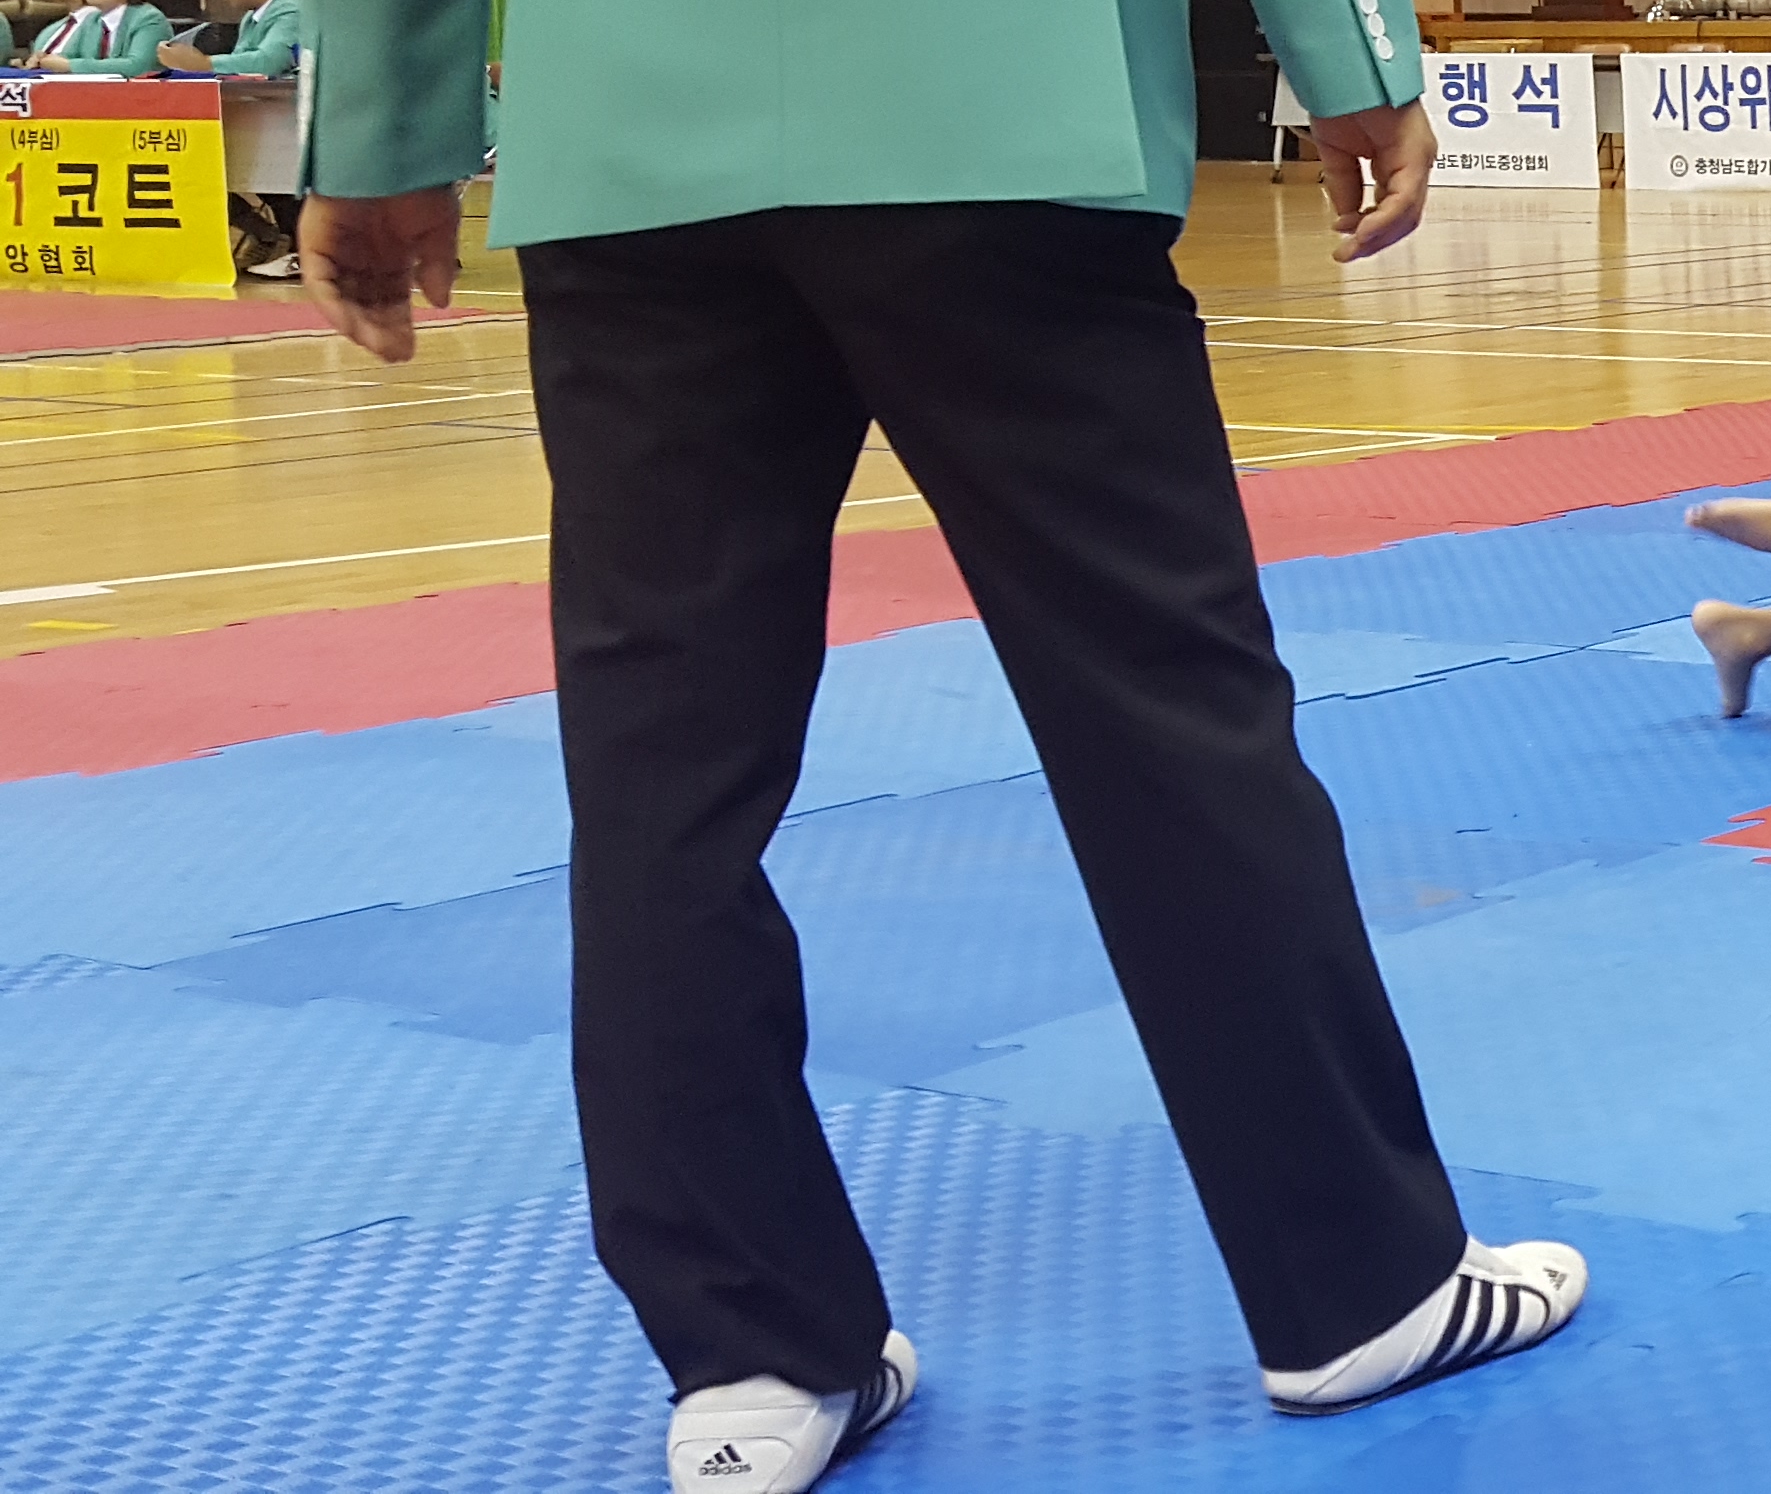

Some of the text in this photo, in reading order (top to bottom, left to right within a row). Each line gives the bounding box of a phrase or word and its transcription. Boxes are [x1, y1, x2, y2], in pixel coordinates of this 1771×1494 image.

[10, 127, 188, 153] (4부심) (5부심)
[1435, 153, 1549, 171] 남도합기도중앙협회
